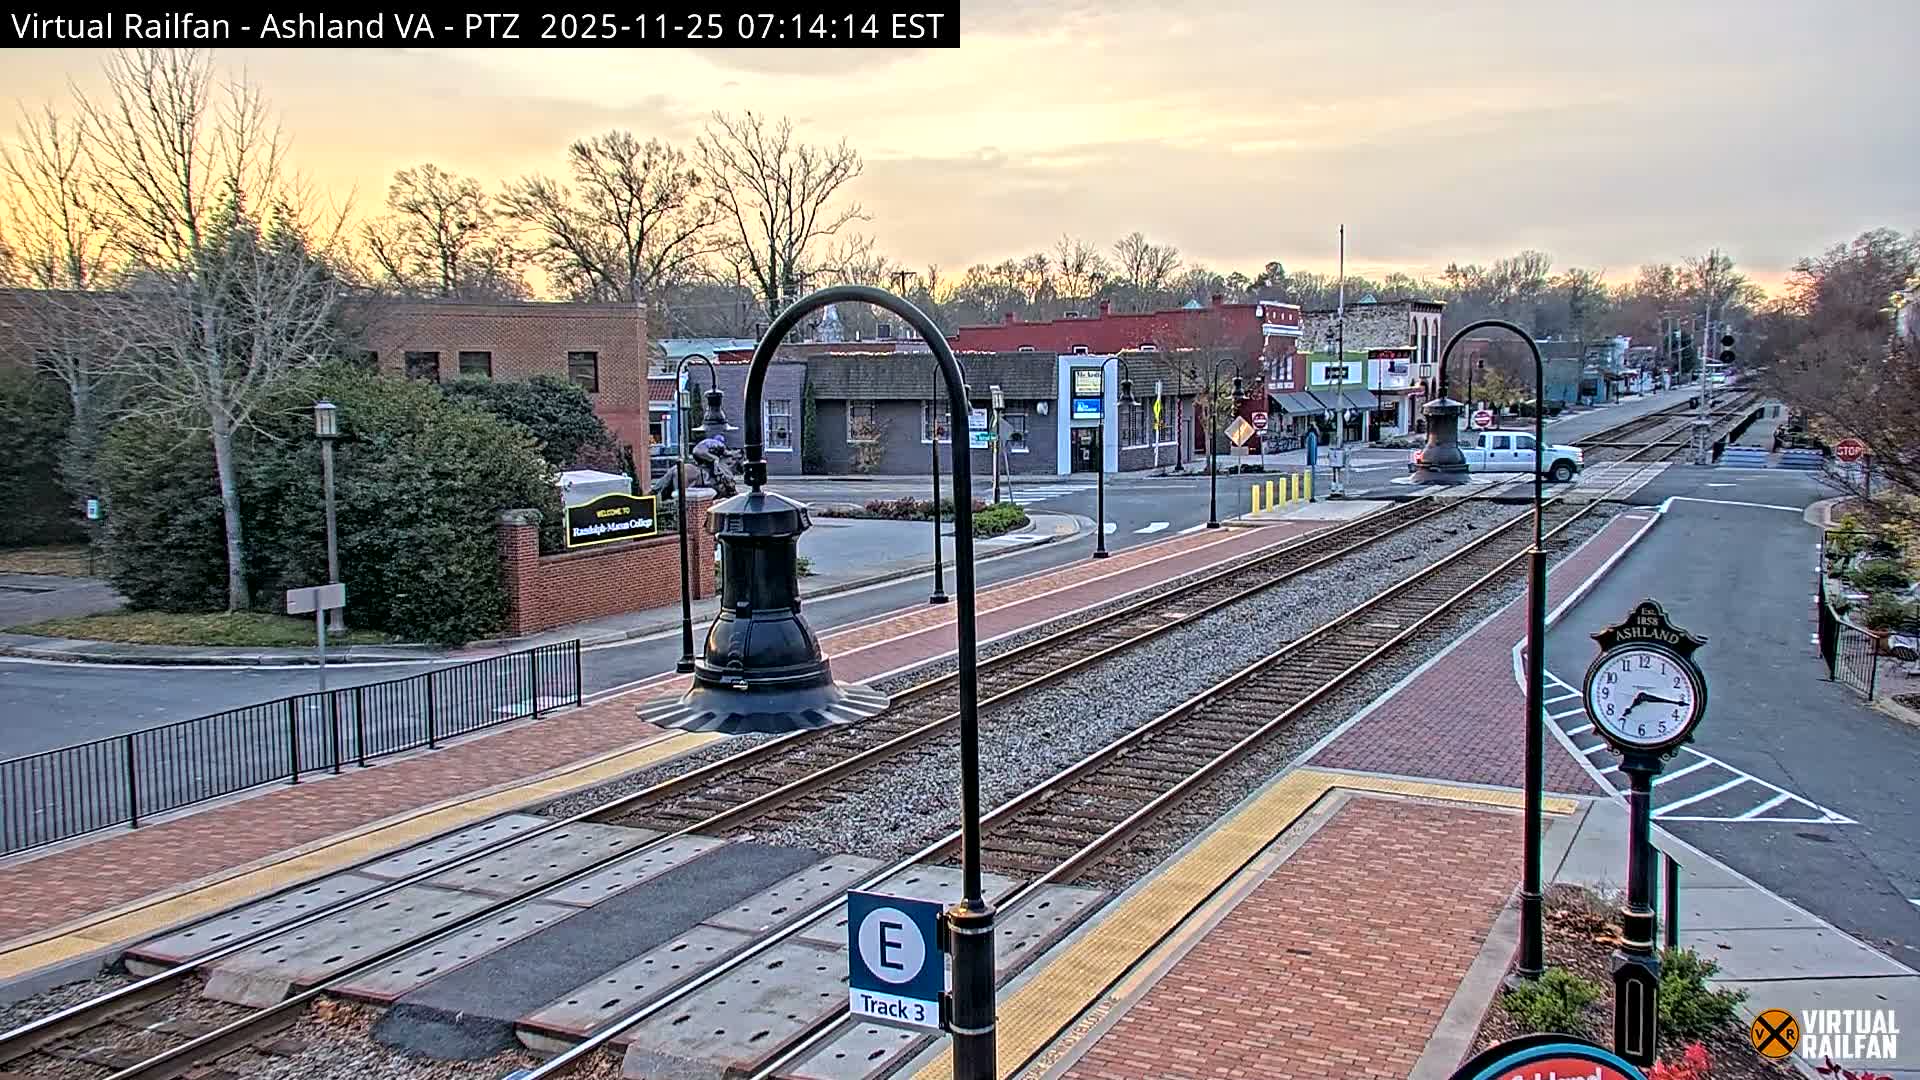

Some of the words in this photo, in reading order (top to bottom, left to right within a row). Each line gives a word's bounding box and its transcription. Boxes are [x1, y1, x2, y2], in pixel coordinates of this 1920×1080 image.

[1837, 446, 1861, 456] STOP
[630, 518, 652, 528] College
[1637, 616, 1658, 626] 1858
[1616, 627, 1680, 644] ASHLAND
[1621, 660, 1631, 672] 11
[1639, 655, 1651, 669] 12
[1660, 663, 1666, 675] 1
[1606, 672, 1618, 684] 10
[1673, 676, 1681, 689] 2
[1602, 687, 1609, 700] 9
[1606, 704, 1615, 716] 8
[1671, 709, 1680, 721] 4
[1619, 717, 1627, 731] 7
[1638, 724, 1646, 737] 6
[1658, 721, 1666, 734] 5
[879, 920, 904, 971] E
[860, 994, 909, 1019] Track
[914, 1003, 926, 1021] 3
